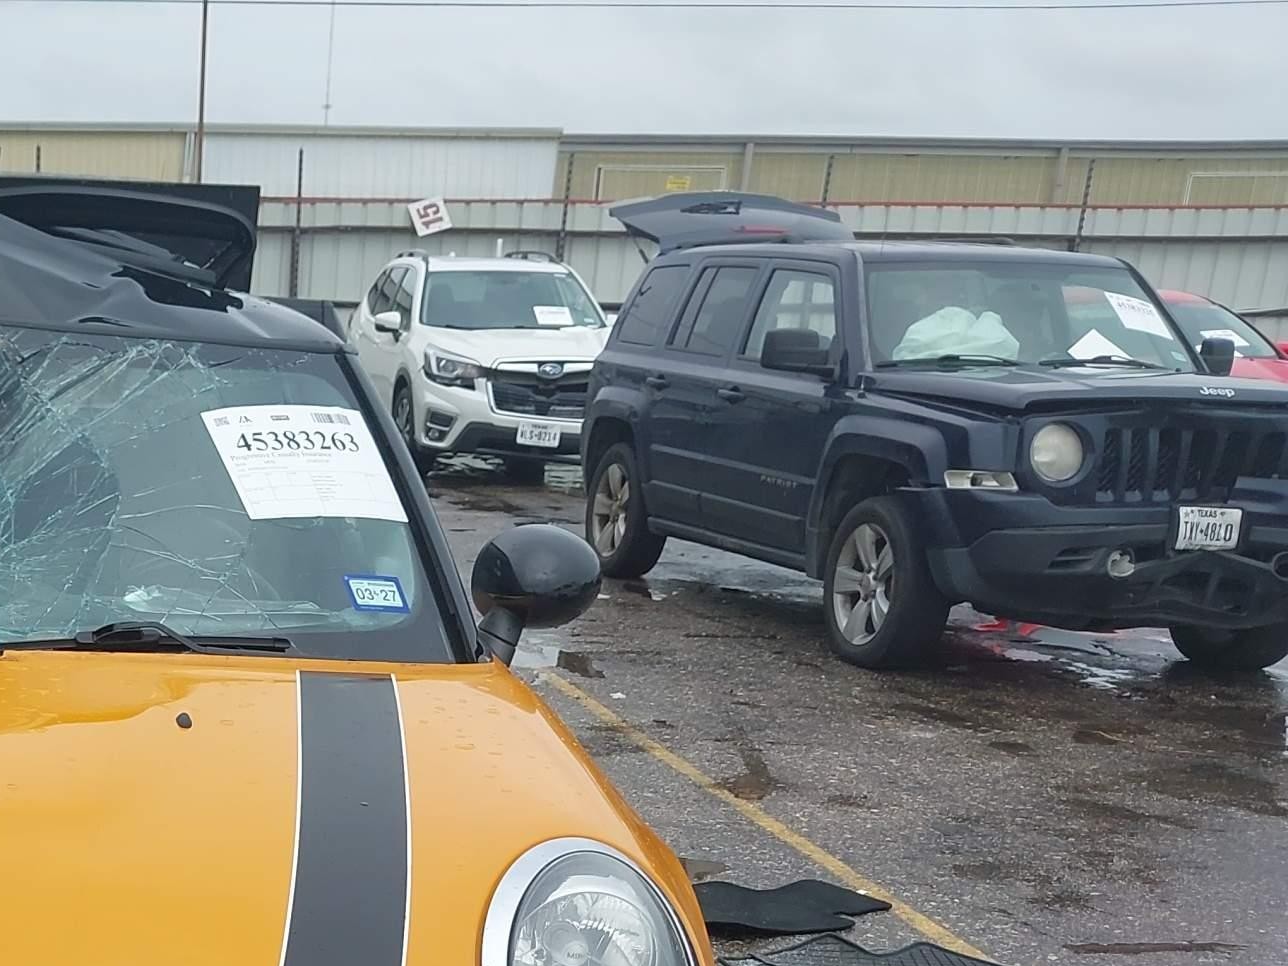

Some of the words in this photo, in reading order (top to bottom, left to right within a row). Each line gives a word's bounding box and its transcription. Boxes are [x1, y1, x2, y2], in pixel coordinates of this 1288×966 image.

[416, 202, 444, 230] 15
[1199, 386, 1235, 398] Jeep
[236, 430, 360, 453] 45383263
[1197, 509, 1218, 519] TEXAS
